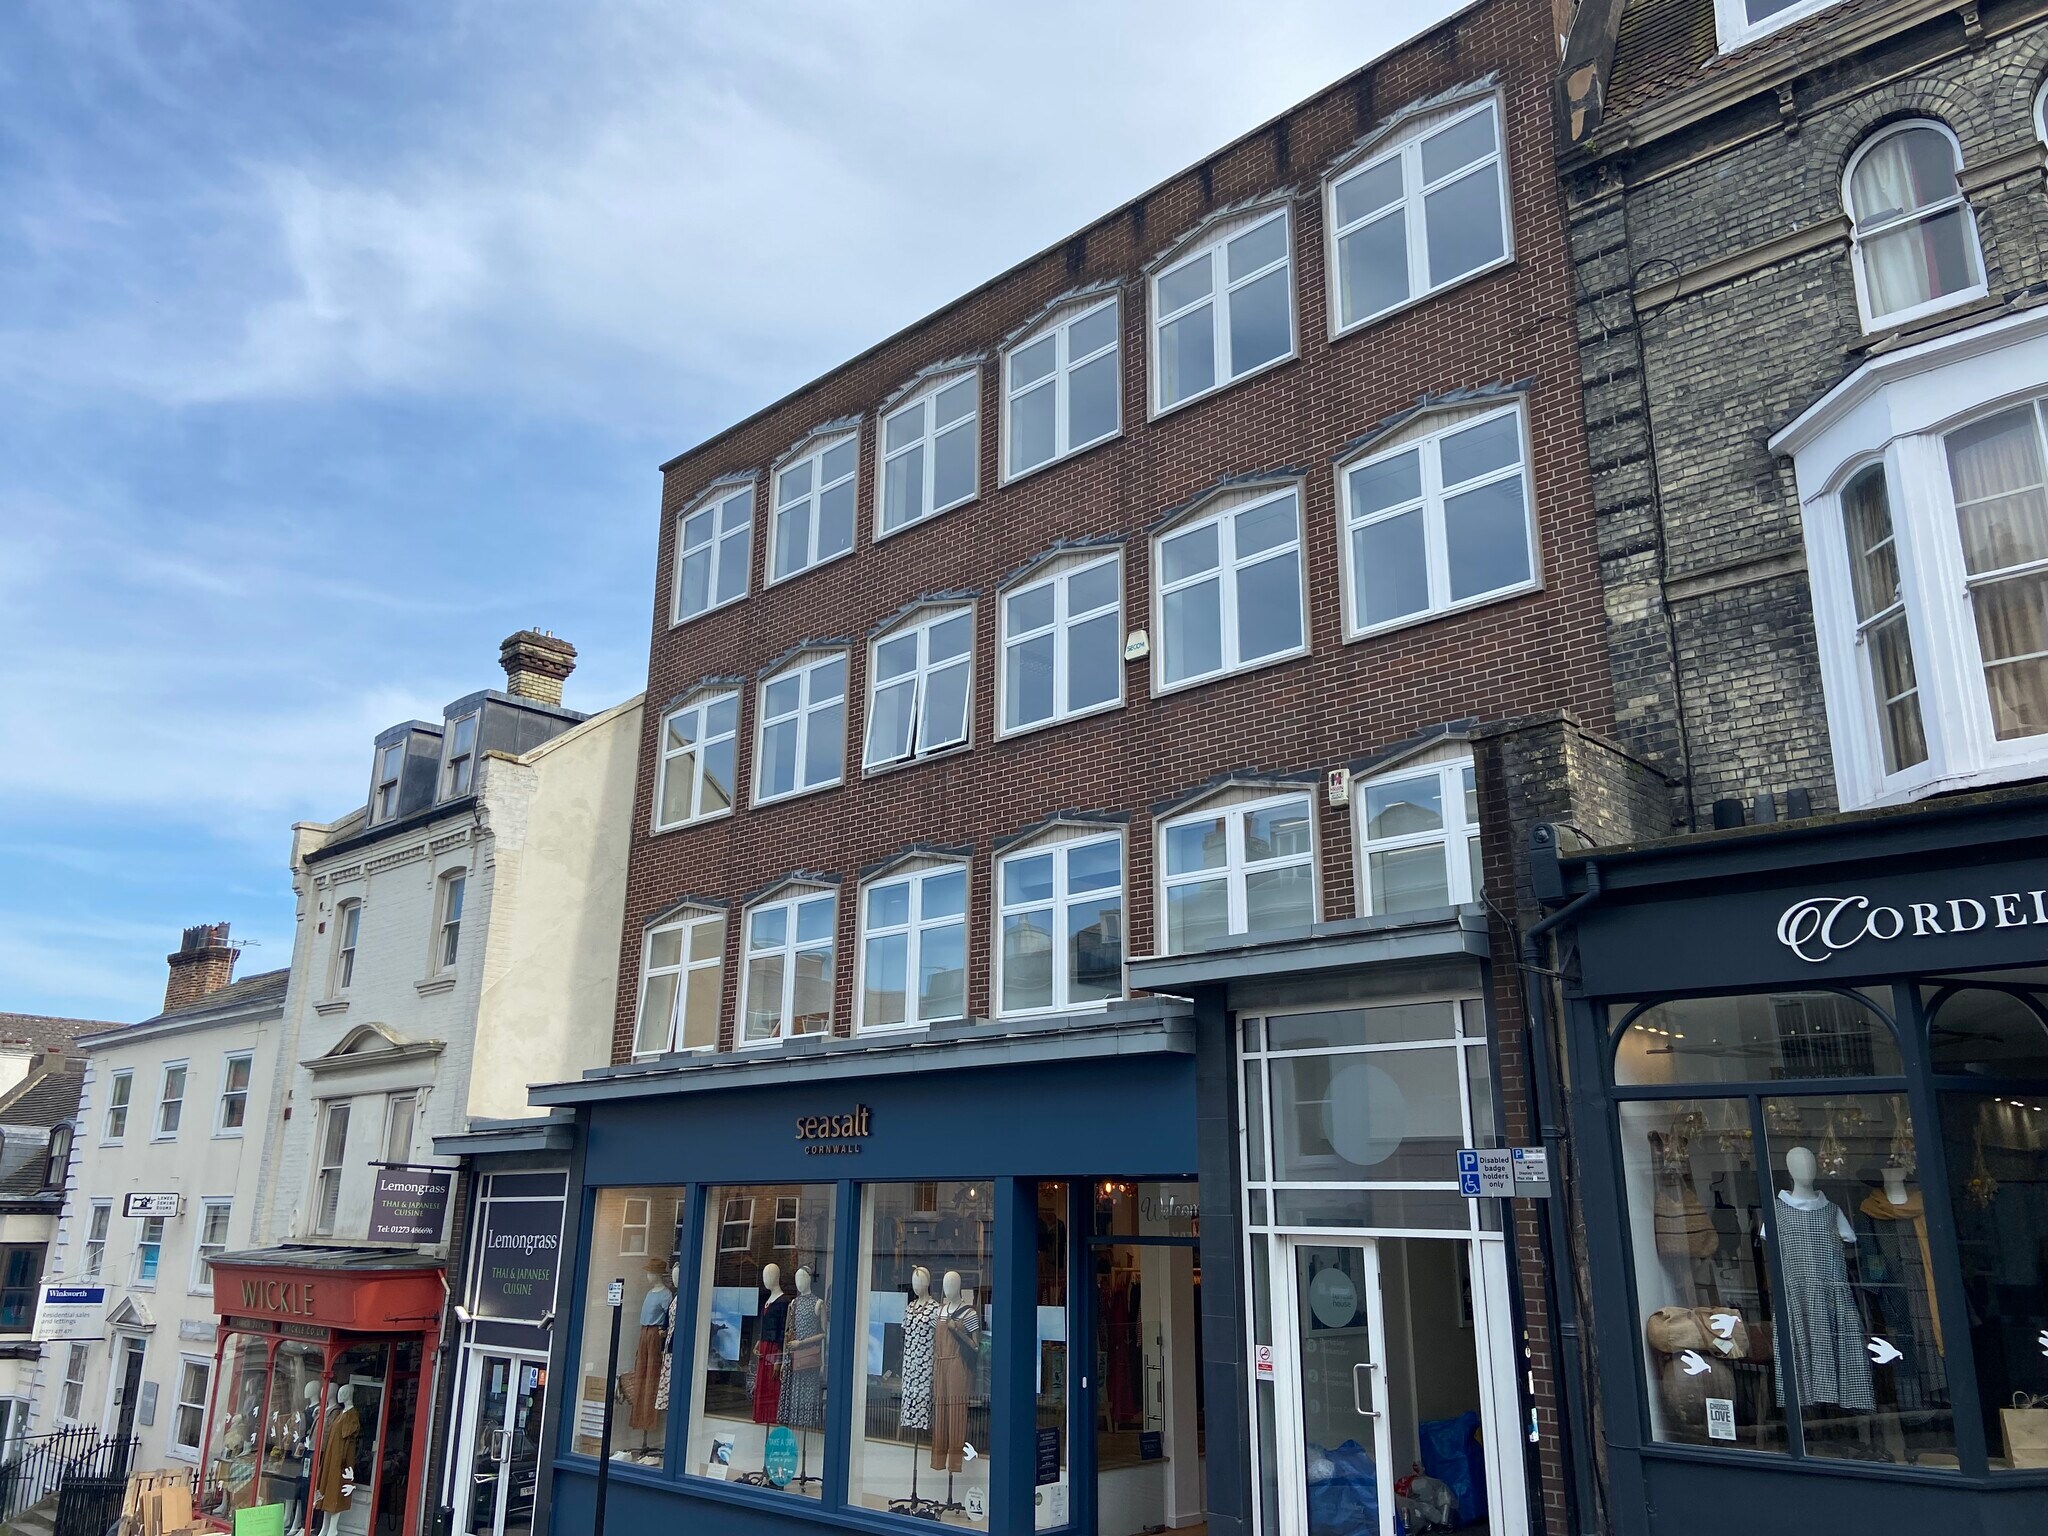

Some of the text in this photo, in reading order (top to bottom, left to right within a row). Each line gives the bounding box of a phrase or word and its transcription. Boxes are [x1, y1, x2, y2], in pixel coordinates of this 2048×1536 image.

[795, 1103, 869, 1139] seasalt
[804, 1143, 860, 1155] CORNWALL
[380, 1179, 446, 1196] Lemongrass
[382, 1200, 441, 1210] THAI & JAPANESE
[394, 1209, 424, 1217] CUISINE
[377, 1225, 390, 1233] Tel:
[390, 1226, 410, 1234] 01273
[487, 1229, 557, 1256] Lemongrass
[492, 1267, 550, 1281] THAI & JAPANESE
[502, 1283, 533, 1296] CUISINE
[241, 1279, 315, 1316] WICKLE
[54, 1318, 77, 1326] lettings
[1709, 1402, 1730, 1410] CHOOSE
[1710, 1410, 1731, 1422] LOVE
